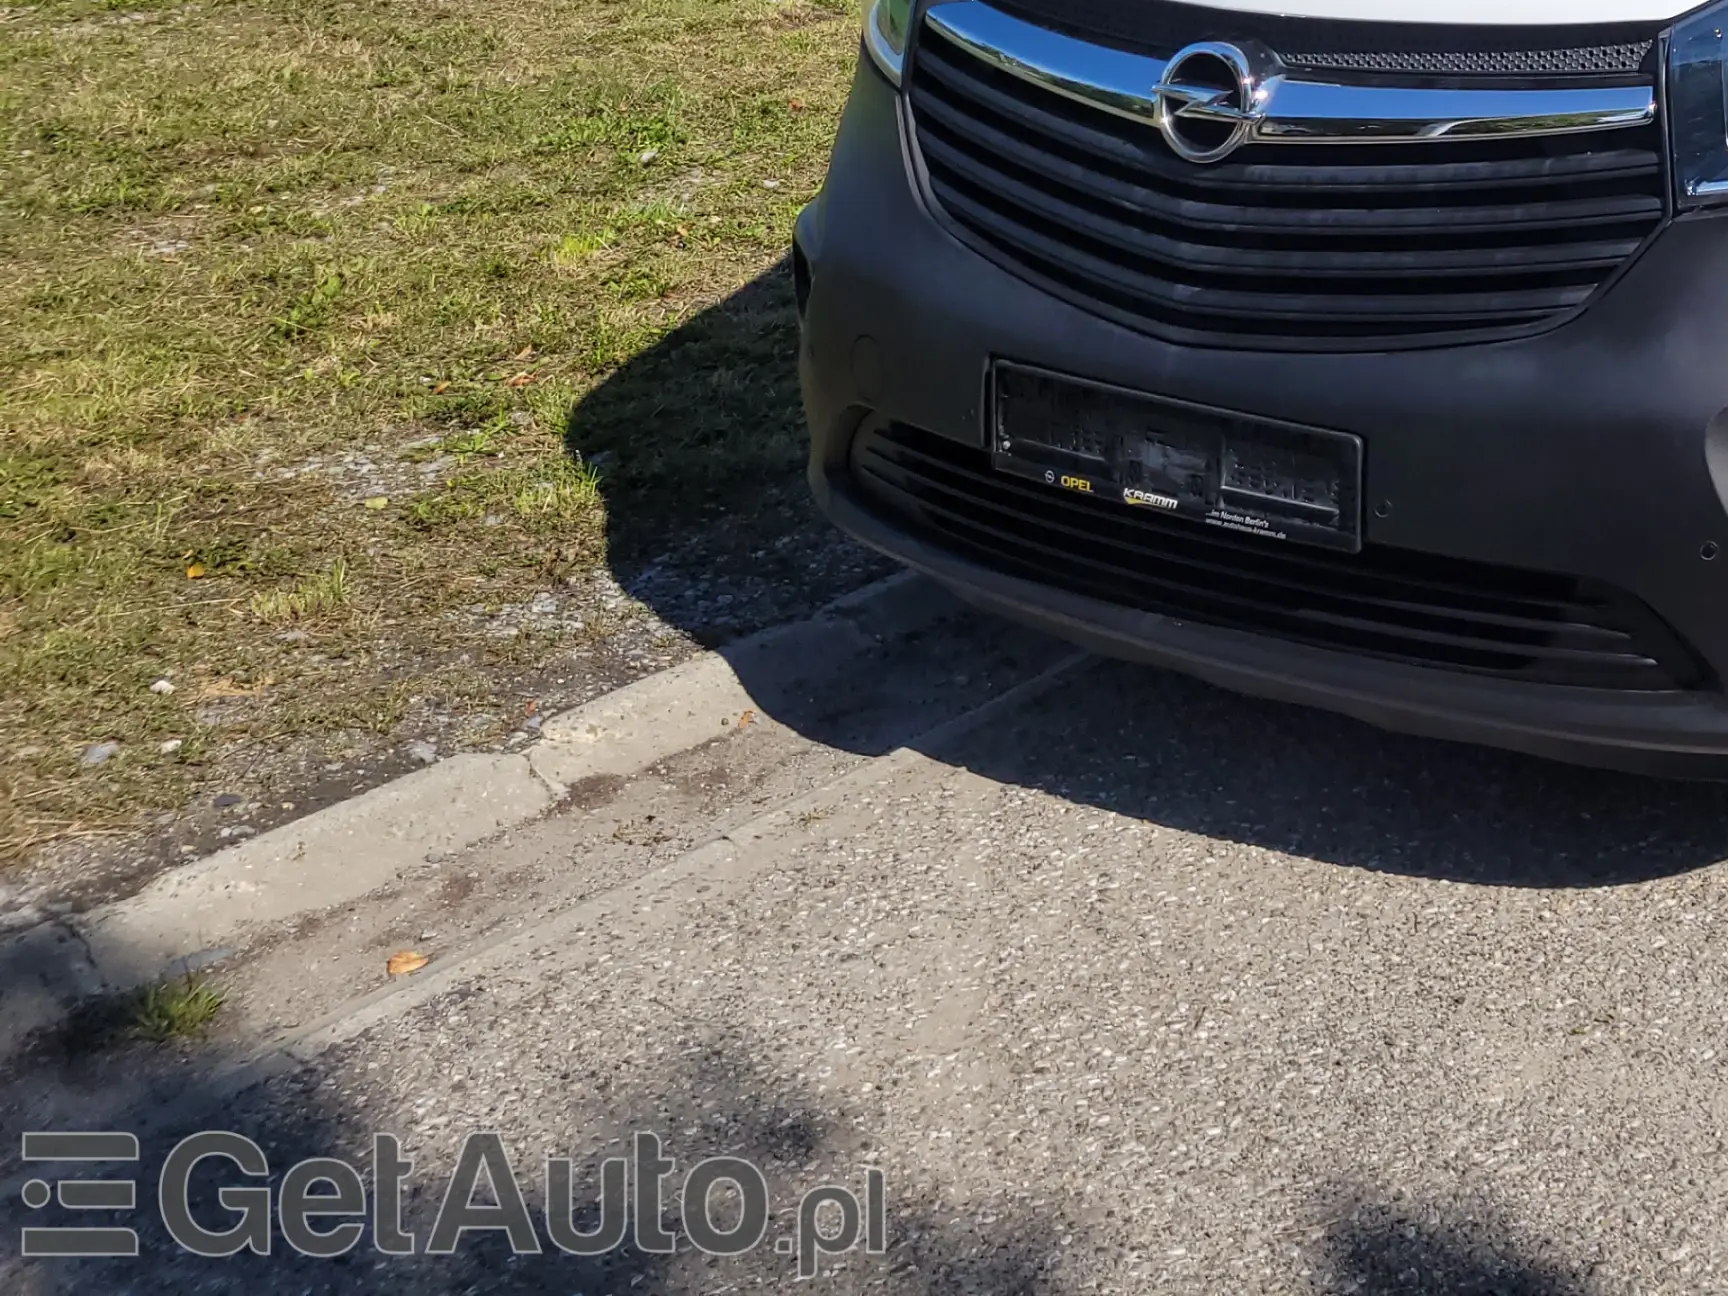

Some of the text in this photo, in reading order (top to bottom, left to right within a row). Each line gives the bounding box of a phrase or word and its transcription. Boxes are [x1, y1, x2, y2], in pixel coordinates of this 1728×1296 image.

[1060, 475, 1094, 493] OPEL
[1123, 487, 1179, 510] KRAMM
[1220, 510, 1244, 523] Norden
